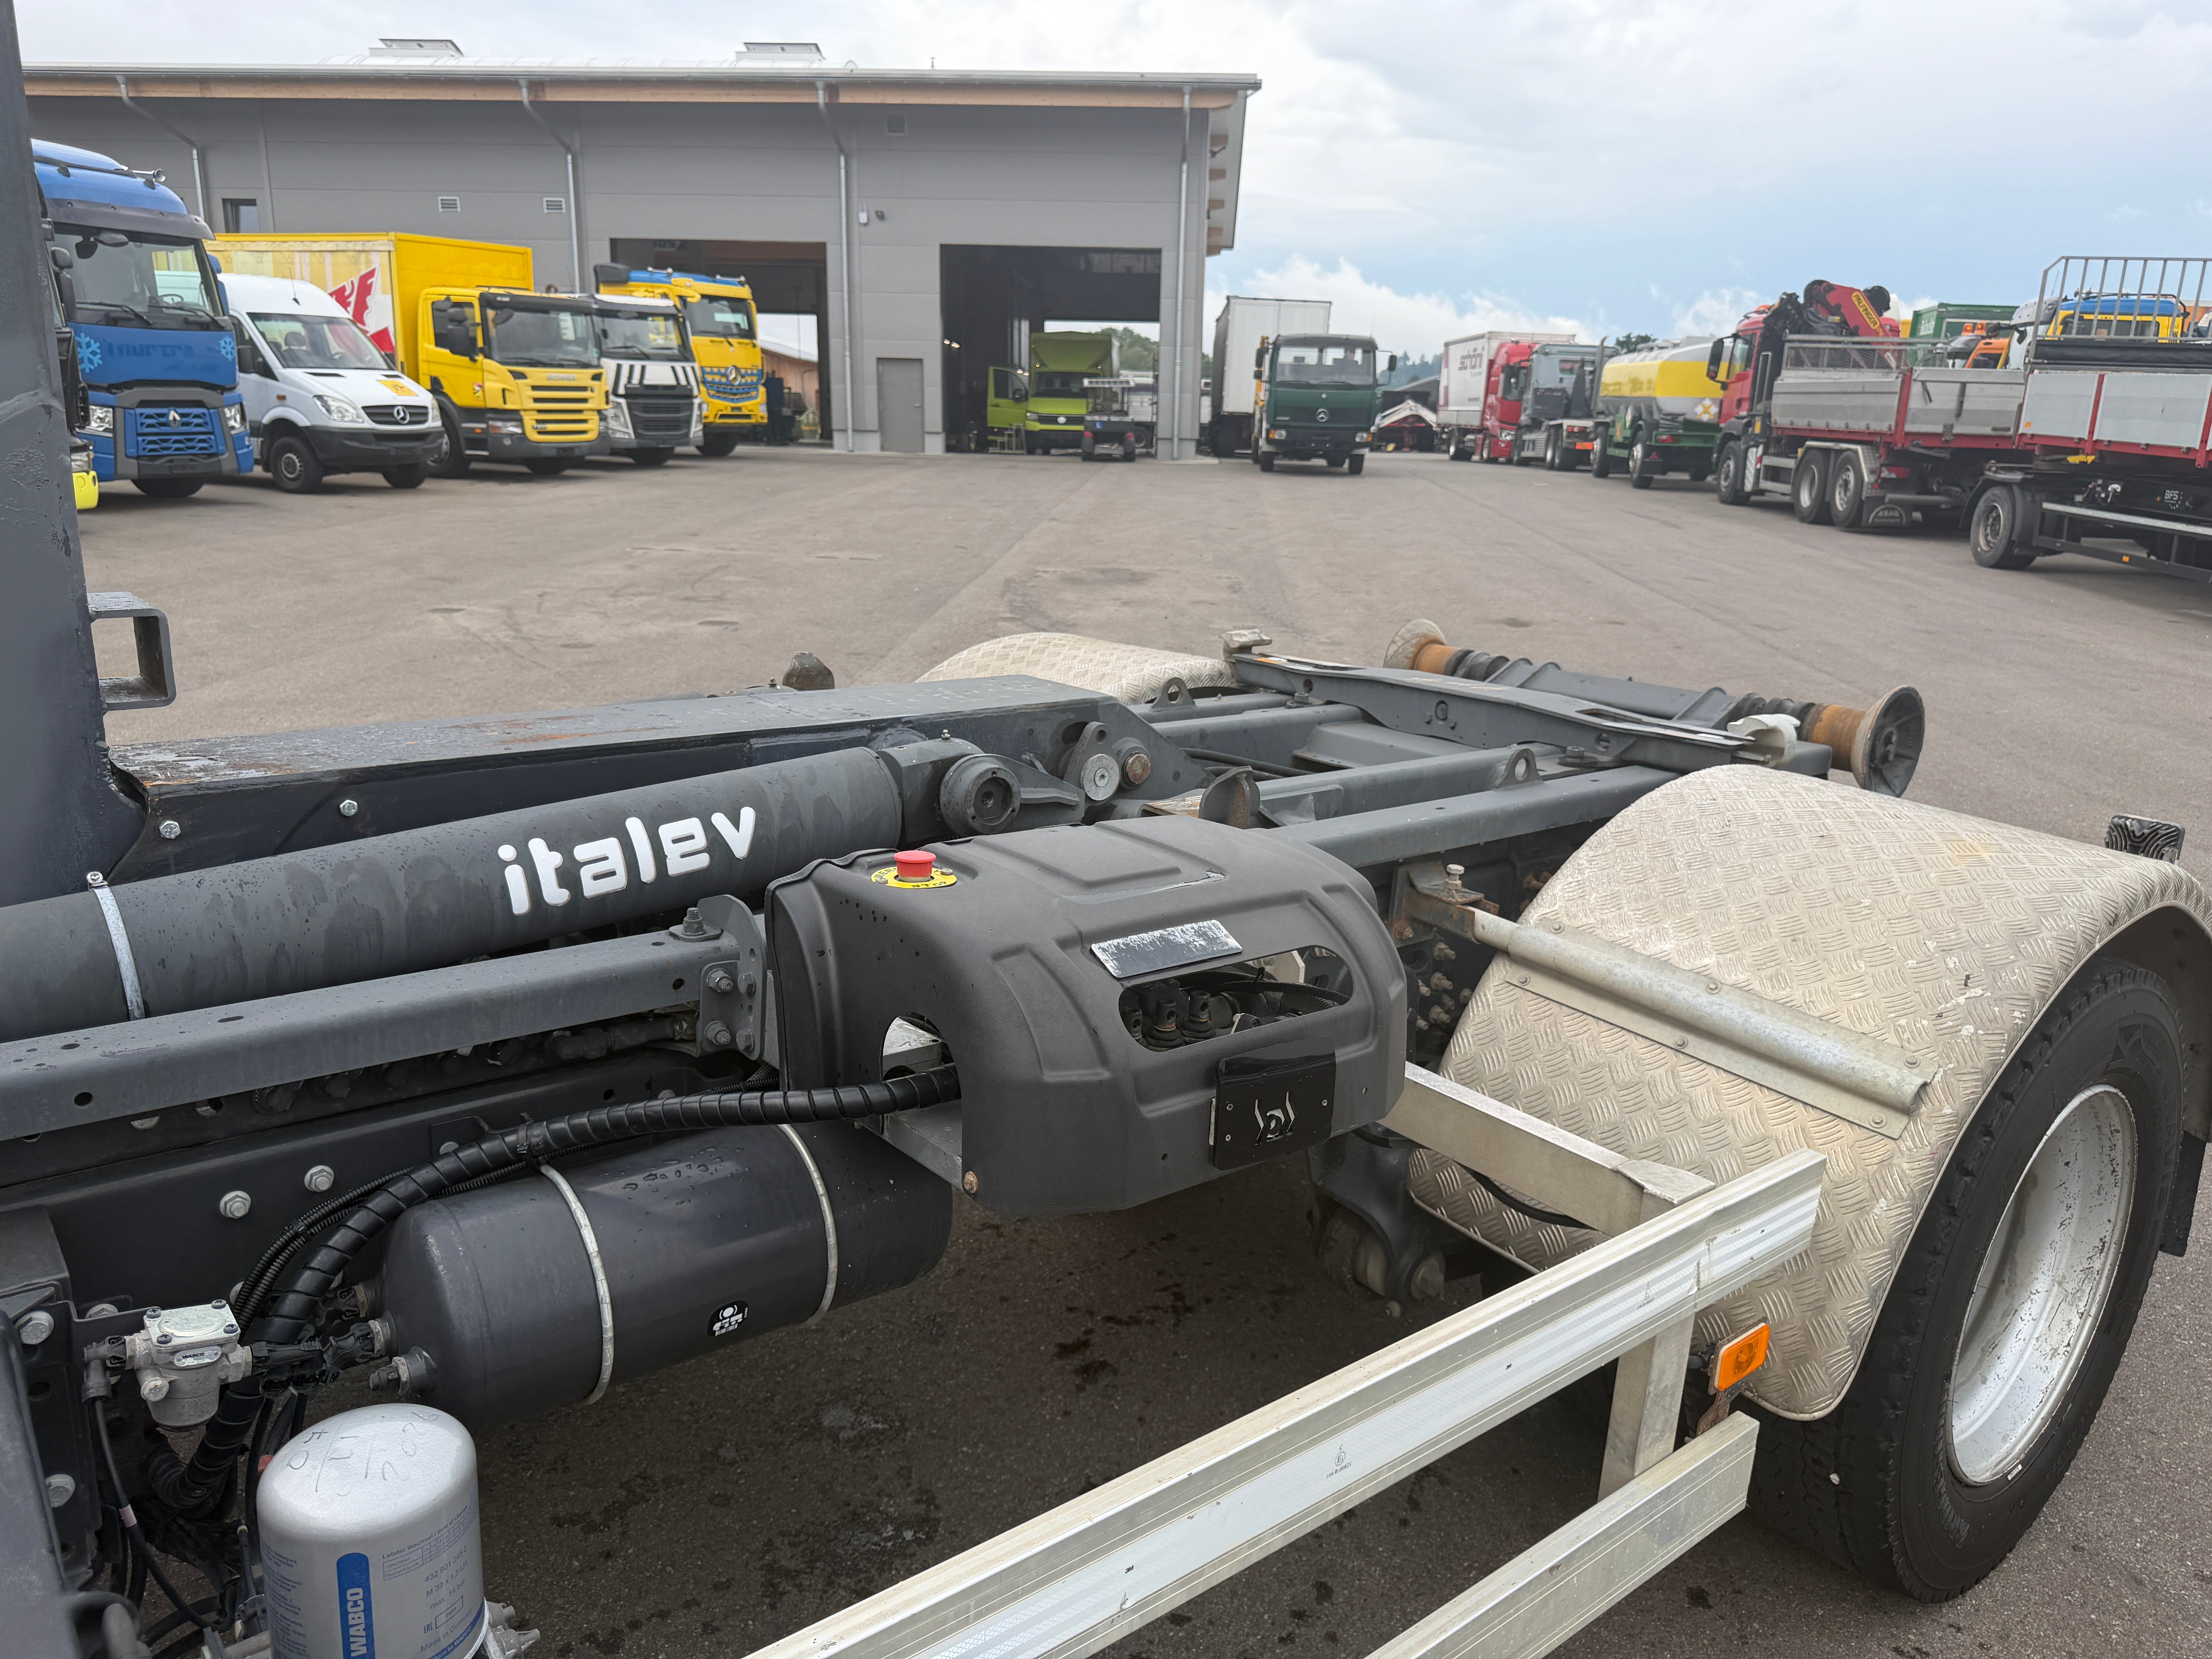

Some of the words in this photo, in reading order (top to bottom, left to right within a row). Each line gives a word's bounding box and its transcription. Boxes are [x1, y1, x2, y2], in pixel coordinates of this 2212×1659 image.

[1854, 293, 1878, 326] PALFINGER
[2164, 489, 2179, 501] BFS
[498, 807, 756, 916] italev
[383, 1548, 406, 1559] Letzter
[407, 1534, 433, 1550] Wechsel
[438, 1524, 448, 1534] date
[424, 1570, 438, 1582] 432
[440, 1561, 451, 1573] 901
[1125, 1565, 1134, 1573] 3M
[426, 1588, 433, 1597] M
[435, 1582, 443, 1592] 39
[430, 1596, 447, 1610] max.
[449, 1587, 455, 1597] 14
[457, 1578, 465, 1590] bar
[346, 1587, 367, 1657] WABCO
[421, 1637, 441, 1653] Made
